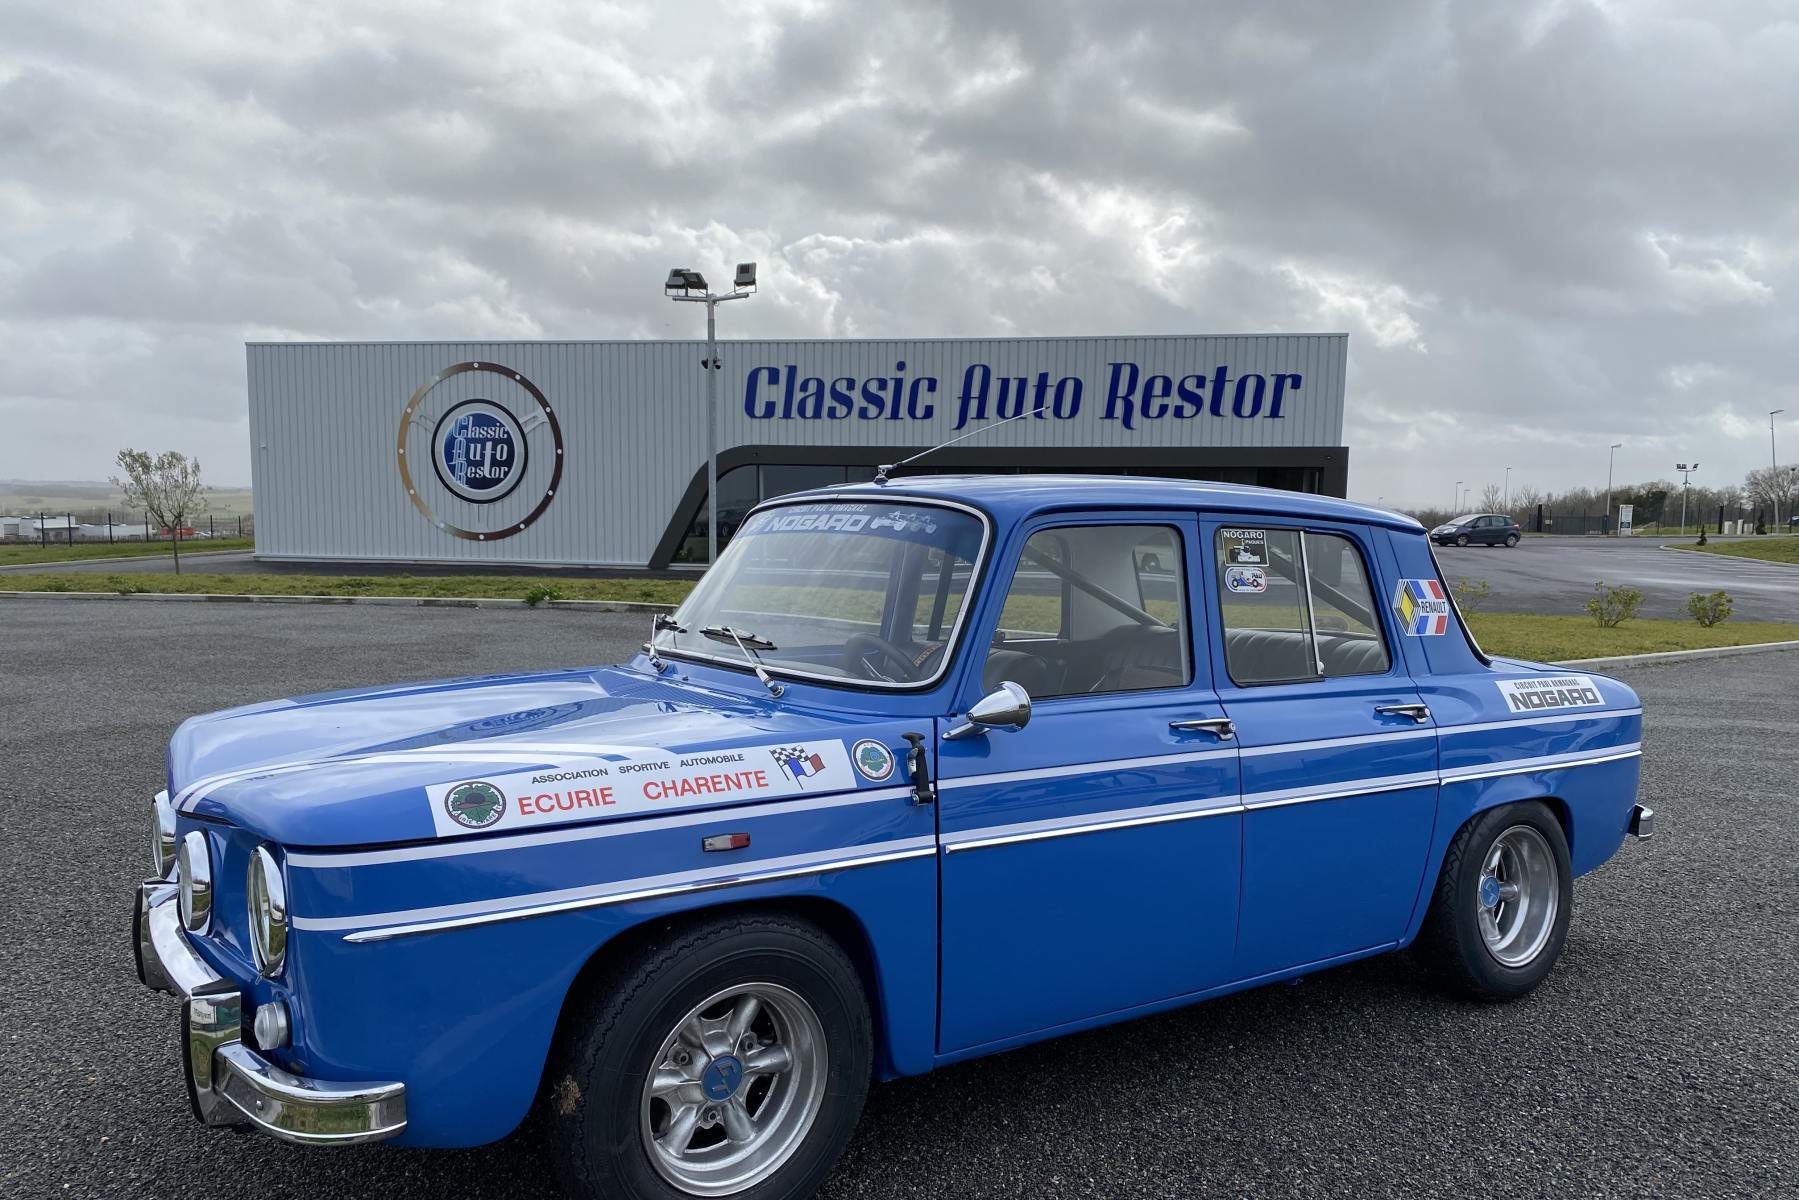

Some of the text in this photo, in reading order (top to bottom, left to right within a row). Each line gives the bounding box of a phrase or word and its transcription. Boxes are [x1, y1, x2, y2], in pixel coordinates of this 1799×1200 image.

[744, 361, 1302, 430] Classic Auto Restor
[452, 416, 508, 438] Classic
[449, 437, 508, 467] Auto
[453, 459, 508, 488] Restor
[764, 514, 871, 531] NOGARO
[1223, 531, 1263, 539] NOGARO
[1420, 601, 1446, 613] RENAULT
[1514, 681, 1538, 690] CIRCUIT
[1509, 688, 1600, 710] NOGARO
[531, 753, 745, 785] ASSOCIATION SPORTIVE AUTOMOBILE
[517, 770, 769, 815] ECURIE CHARENTE
